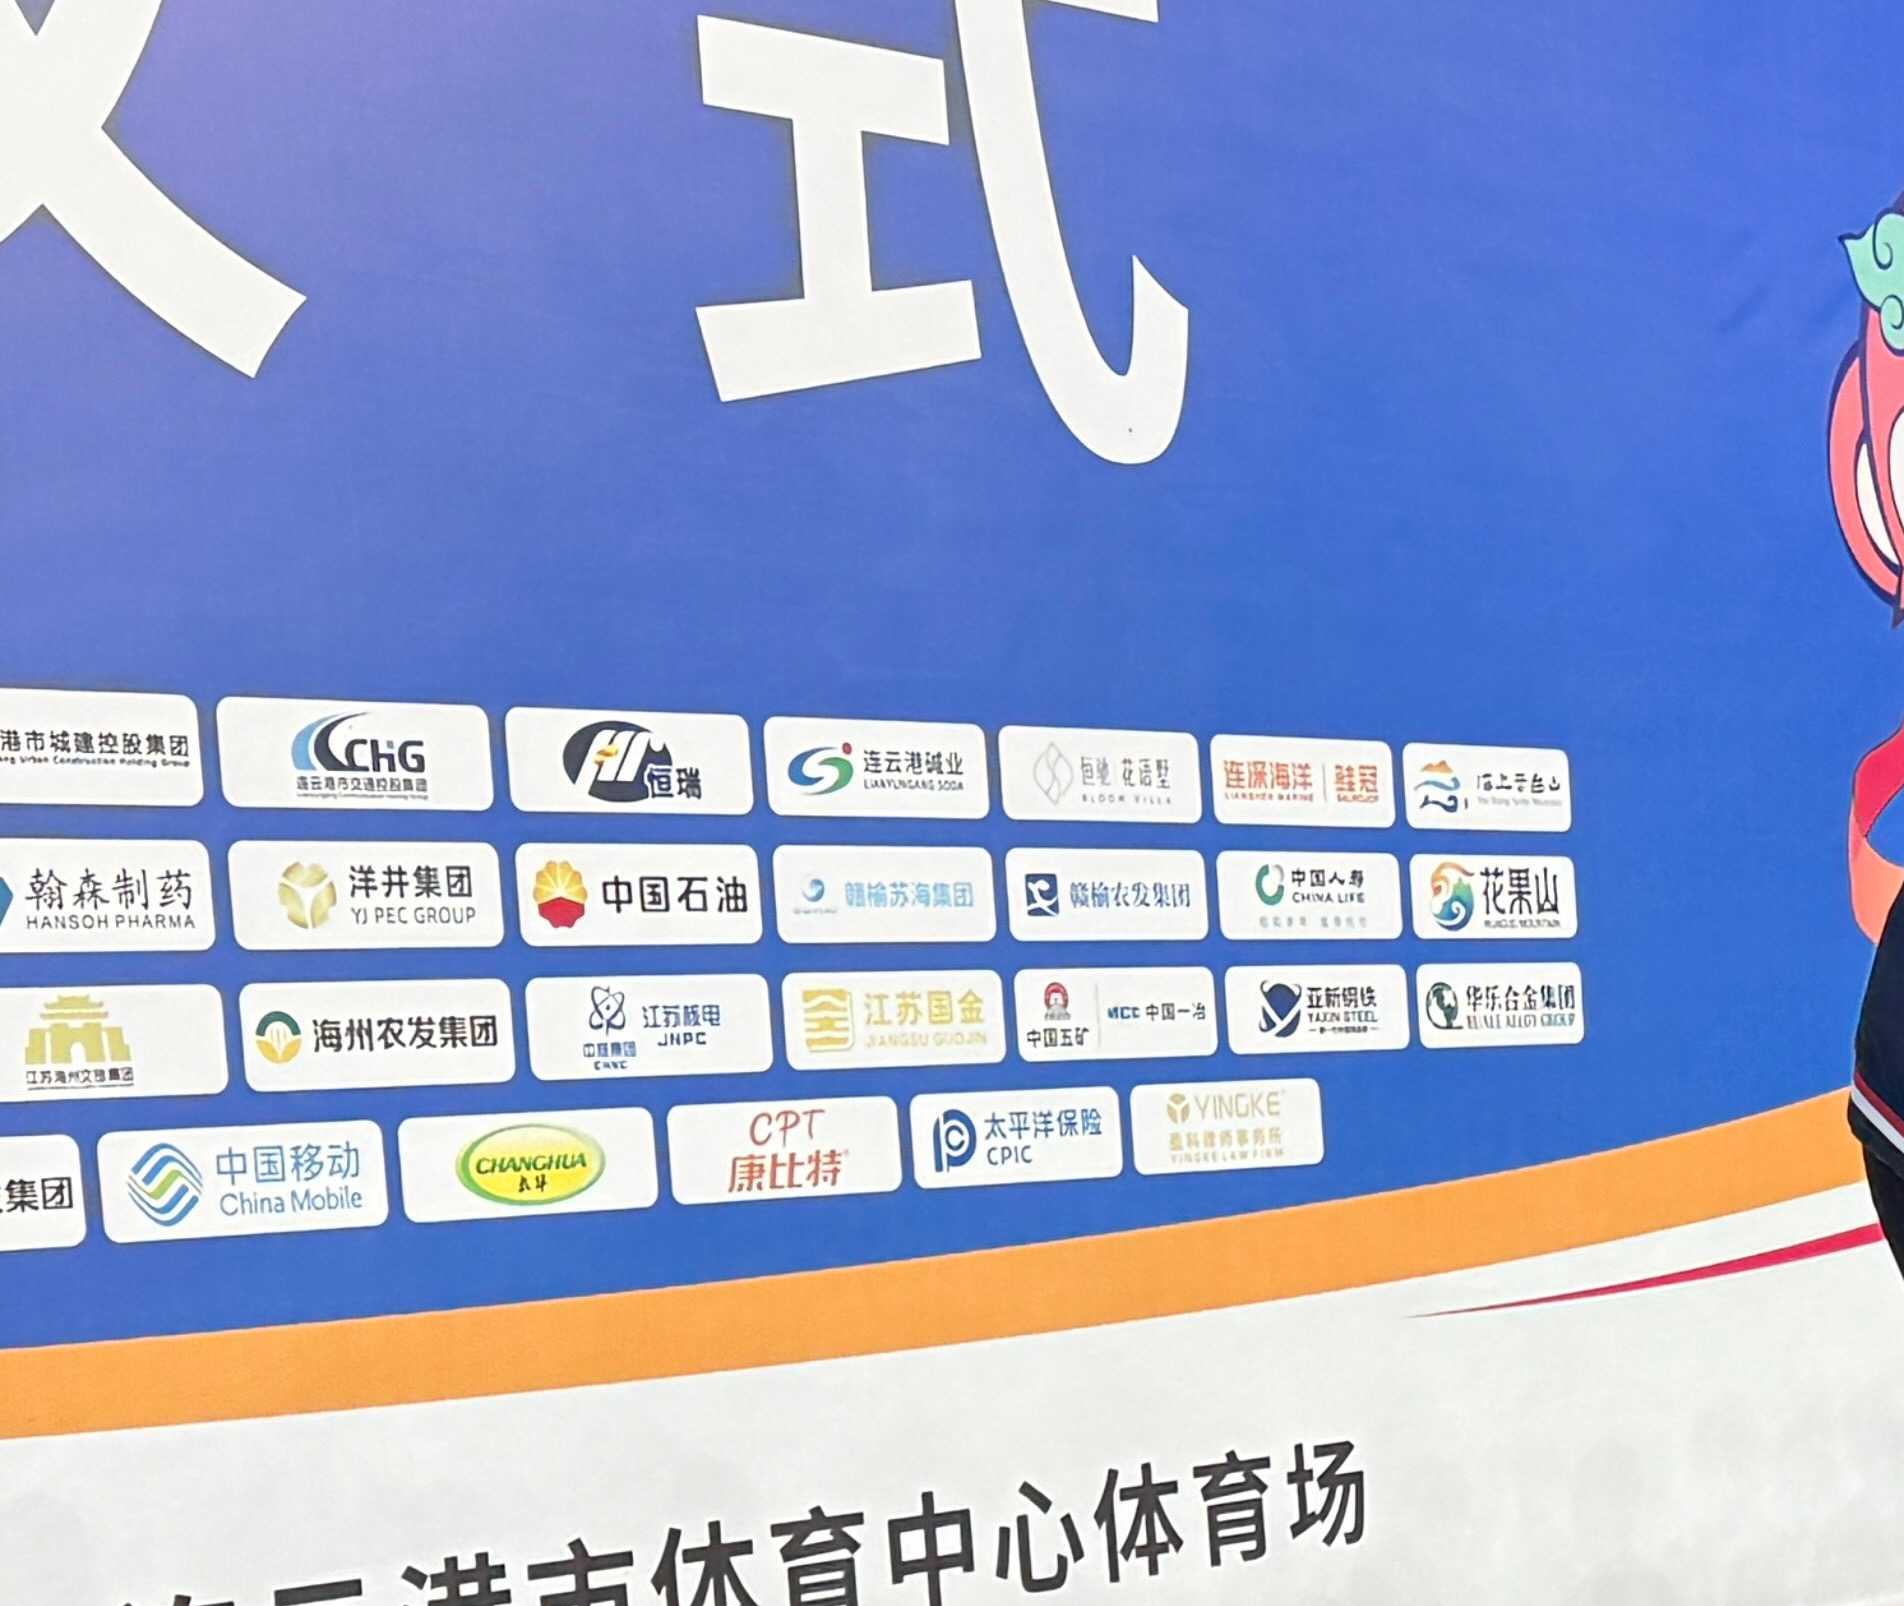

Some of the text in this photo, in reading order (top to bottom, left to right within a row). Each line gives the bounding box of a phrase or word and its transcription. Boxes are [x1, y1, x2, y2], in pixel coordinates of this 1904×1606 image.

[863, 749, 964, 776] 连云港碱业
[647, 766, 702, 800] 恒瑞
[25, 867, 193, 911] 翰森制药
[348, 864, 473, 898] 洋井集团
[602, 874, 748, 914] 中国石油
[1291, 868, 1364, 888] 中国人寿
[1480, 867, 1560, 915] 花果山
[1292, 892, 1365, 904] CHINA LIFE
[26, 914, 196, 929] HANSOH PHARMA
[375, 907, 409, 924] PEC
[414, 906, 476, 924] GROUP
[642, 1003, 721, 1029] 江苏核电
[864, 989, 985, 1026] 江苏国金
[312, 1015, 498, 1053] 海州农发集团
[657, 1031, 707, 1048] JNPC
[1027, 1027, 1089, 1048] 中国五矿
[1194, 1091, 1281, 1120] YINGKE
[750, 1109, 825, 1148] CPT
[984, 1108, 1102, 1140] 太平洋保险
[216, 1140, 360, 1187] 中国移动
[475, 1151, 587, 1175] CHANGHUA
[728, 1149, 842, 1194] 康比特
[987, 1145, 1033, 1166] CPIC
[0, 1176, 74, 1213] 集团
[220, 1185, 363, 1217] China Mobile
